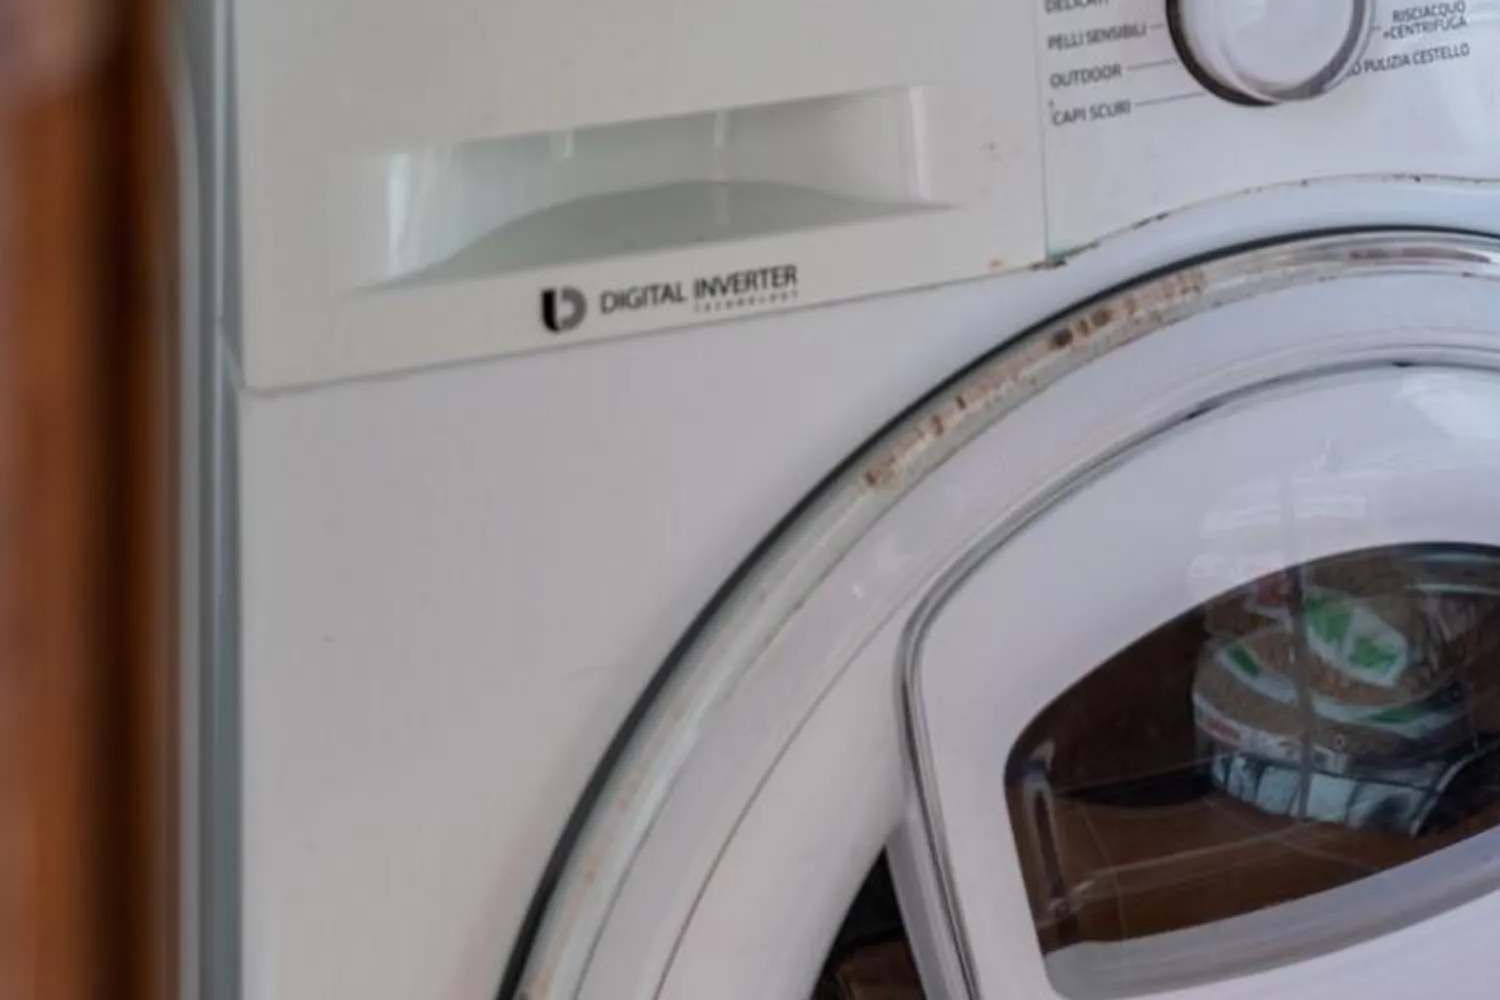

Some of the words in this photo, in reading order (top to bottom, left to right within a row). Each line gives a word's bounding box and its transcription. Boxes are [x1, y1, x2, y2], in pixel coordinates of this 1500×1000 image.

[1412, 43, 1470, 66] CESTELLO
[1049, 64, 1122, 88] OUTDOOR
[1053, 107, 1086, 126] CAPI
[601, 281, 686, 315] DIGITAL
[694, 264, 798, 298] INVERTER
